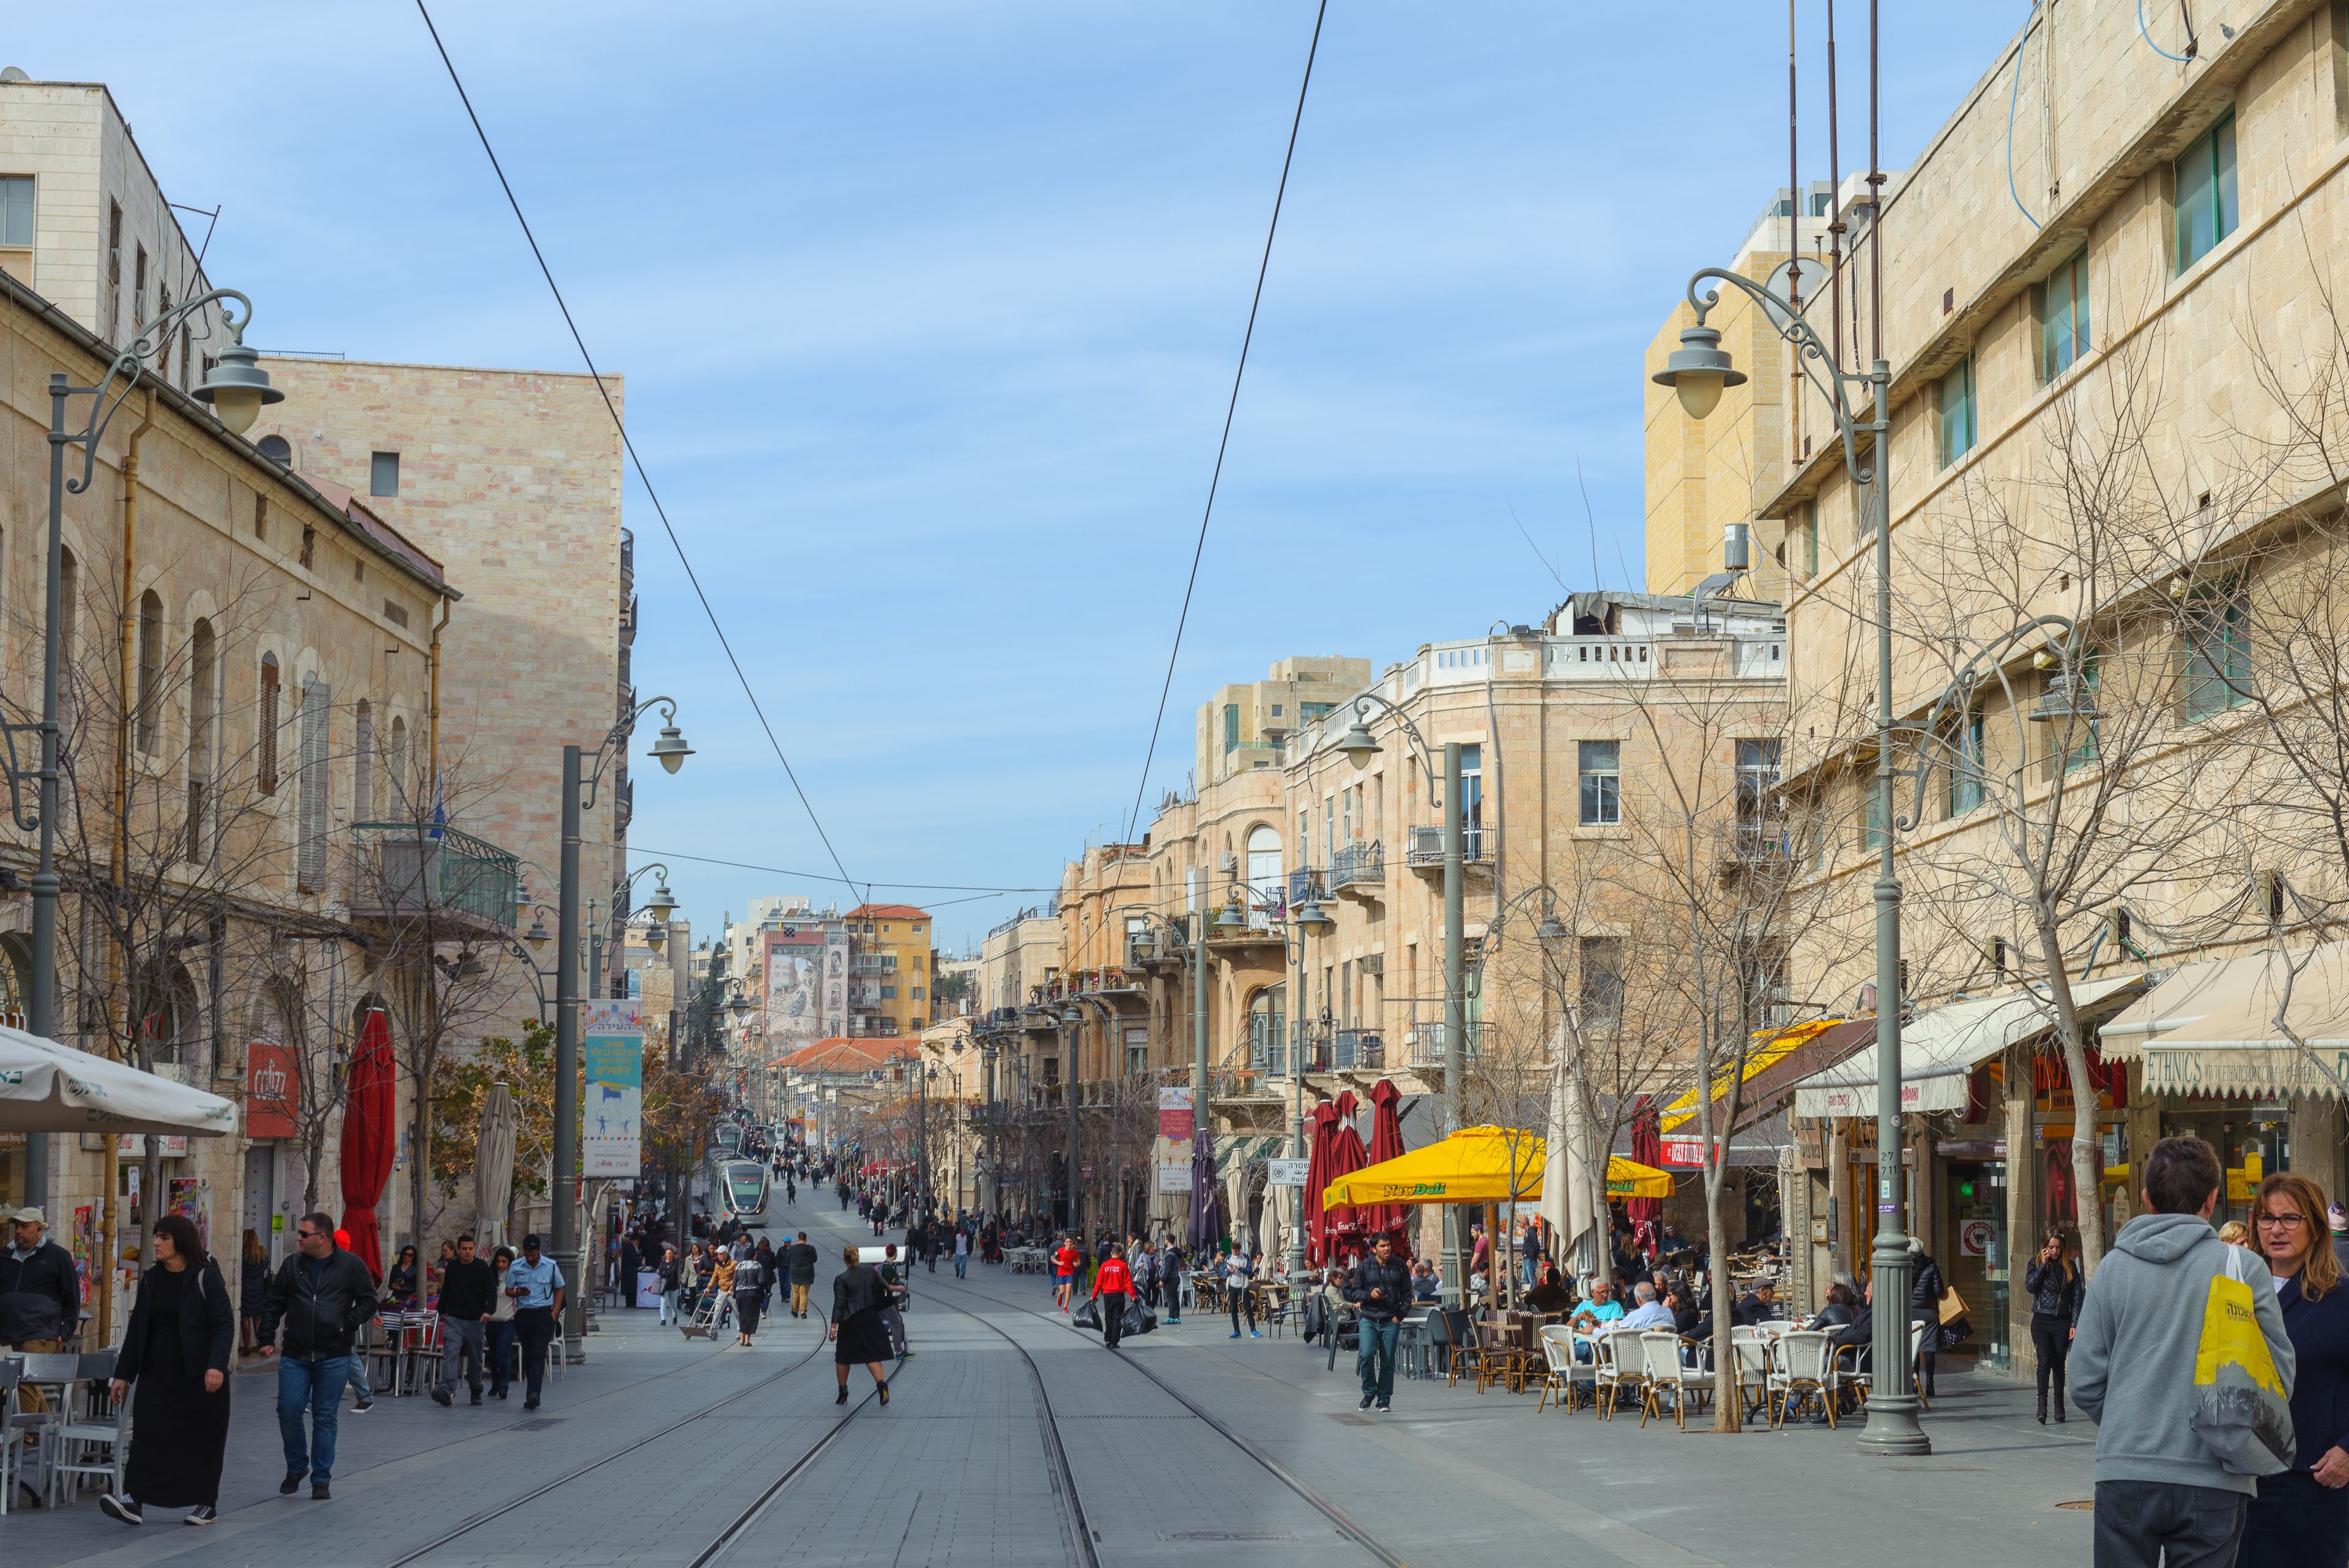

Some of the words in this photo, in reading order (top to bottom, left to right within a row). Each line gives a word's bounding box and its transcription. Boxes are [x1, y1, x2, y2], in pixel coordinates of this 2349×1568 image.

[2147, 1052, 2202, 1084] ETHNICS
[1672, 1143, 1685, 1162] UGLY
[1881, 1151, 1894, 1161] 27
[1606, 1180, 1635, 1192] Deli
